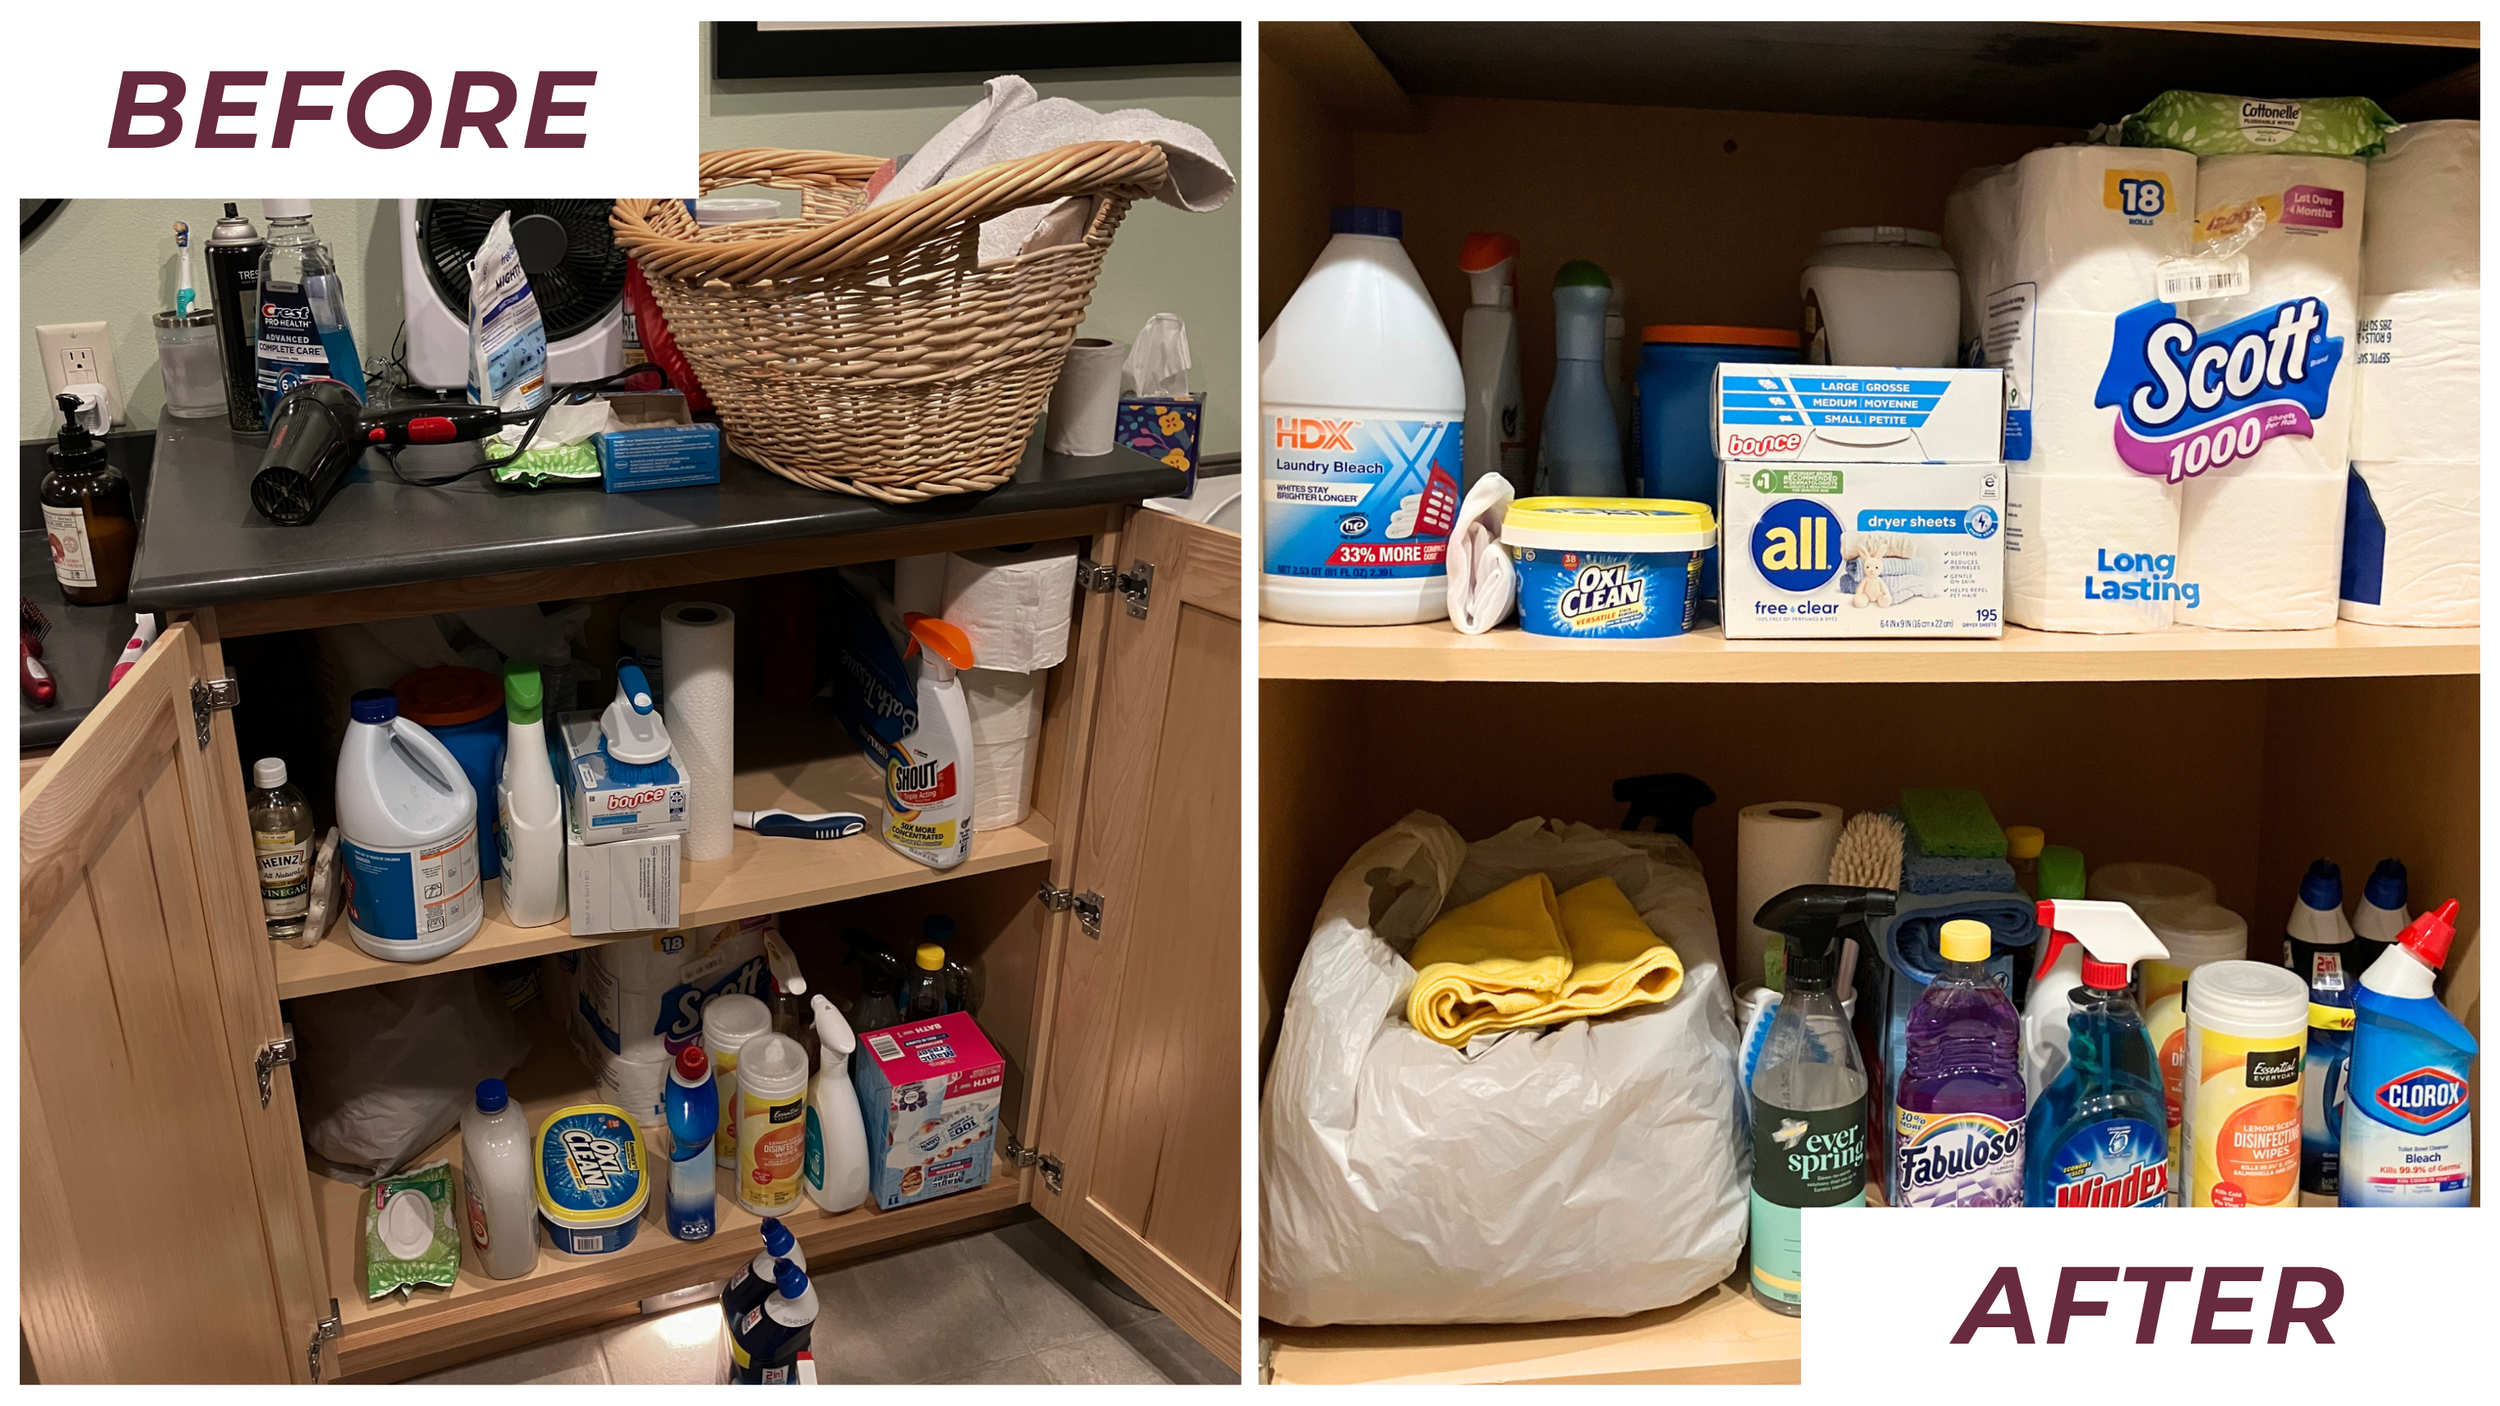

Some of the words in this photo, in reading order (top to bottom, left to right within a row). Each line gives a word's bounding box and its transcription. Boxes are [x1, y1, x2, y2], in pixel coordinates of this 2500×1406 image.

[2243, 103, 2299, 119] Cottonelle
[2119, 178, 2164, 216] 18
[2295, 206, 2333, 218] Months
[262, 303, 309, 319] Crest
[266, 334, 309, 344] ADVANCED
[259, 343, 295, 354] COMPLETE
[2132, 300, 2319, 424] Scott
[1821, 382, 1858, 392] LARGE
[1866, 383, 1910, 392] GROSSE
[1813, 398, 1857, 408] MEDIUM
[1864, 399, 1918, 408] MOYENNE
[1825, 415, 1862, 424] SMALL
[1869, 415, 1907, 425] PETITE
[1276, 417, 1354, 451] HDX
[1728, 433, 1801, 456] bounce
[2167, 415, 2262, 483] 1000
[1277, 458, 1329, 474] Laundry
[1334, 461, 1384, 474] Bleach
[1757, 473, 1770, 489] #1
[1277, 484, 1306, 492] WHITES
[1307, 486, 1329, 494] STAY
[1277, 492, 1317, 501] BRIGHTER
[1868, 515, 1908, 531] dryer
[1910, 516, 1956, 528] sheets
[1762, 516, 1827, 571] all
[1340, 547, 1375, 562] 33%
[1380, 546, 1421, 562] MORE
[1565, 555, 1577, 563] 38
[2097, 547, 2176, 577] Long
[1278, 565, 1291, 573] NET
[1293, 566, 1309, 575] 2.53
[1578, 565, 1626, 593] OXI
[1561, 579, 1642, 618] CLEAN
[2084, 575, 2201, 608] Lasting
[1755, 601, 1788, 614] free
[1797, 601, 1839, 614] clear
[1576, 612, 1616, 625] VERSATILE
[1976, 609, 1997, 621] 195
[896, 759, 937, 791] SHOUT
[607, 788, 665, 810] bounce
[919, 791, 936, 799] Acting
[892, 826, 943, 840] CONCENTRATED
[901, 822, 913, 831] 50X
[262, 855, 299, 868] HEINZ
[275, 868, 300, 878] Natural
[261, 883, 307, 897] VINEGAR
[662, 935, 684, 951] 18
[2317, 957, 2336, 972] 2in1
[915, 1023, 942, 1034] BATH
[918, 1044, 952, 1056] Eraser
[920, 1050, 956, 1062] Magic
[2253, 1058, 2296, 1074] Essential
[973, 1075, 1000, 1087] BATH
[2254, 1072, 2294, 1081] EVERYDAY
[2389, 1082, 2459, 1107] CLOROX
[1901, 1111, 1926, 1124] 30%
[2276, 1118, 2296, 1130] SCENT
[1900, 1121, 1922, 1130] MORE
[1806, 1125, 1858, 1152] ever
[2109, 1130, 2131, 1154] 75
[2234, 1124, 2300, 1148] DISINFECTING
[562, 1130, 609, 1186] CLEAN
[590, 1140, 623, 1173] OXI
[1901, 1127, 2018, 1188] Fabuloso
[2252, 1145, 2289, 1159] WIPES
[2406, 1153, 2441, 1163] Bleach
[1788, 1141, 1864, 1179] spring
[2063, 1161, 2093, 1173] ECONOMY
[2071, 1169, 2085, 1177] SIZE
[932, 1177, 964, 1189] Magic
[2056, 1161, 2168, 1208] Windex
[766, 1369, 785, 1380] 2in1
